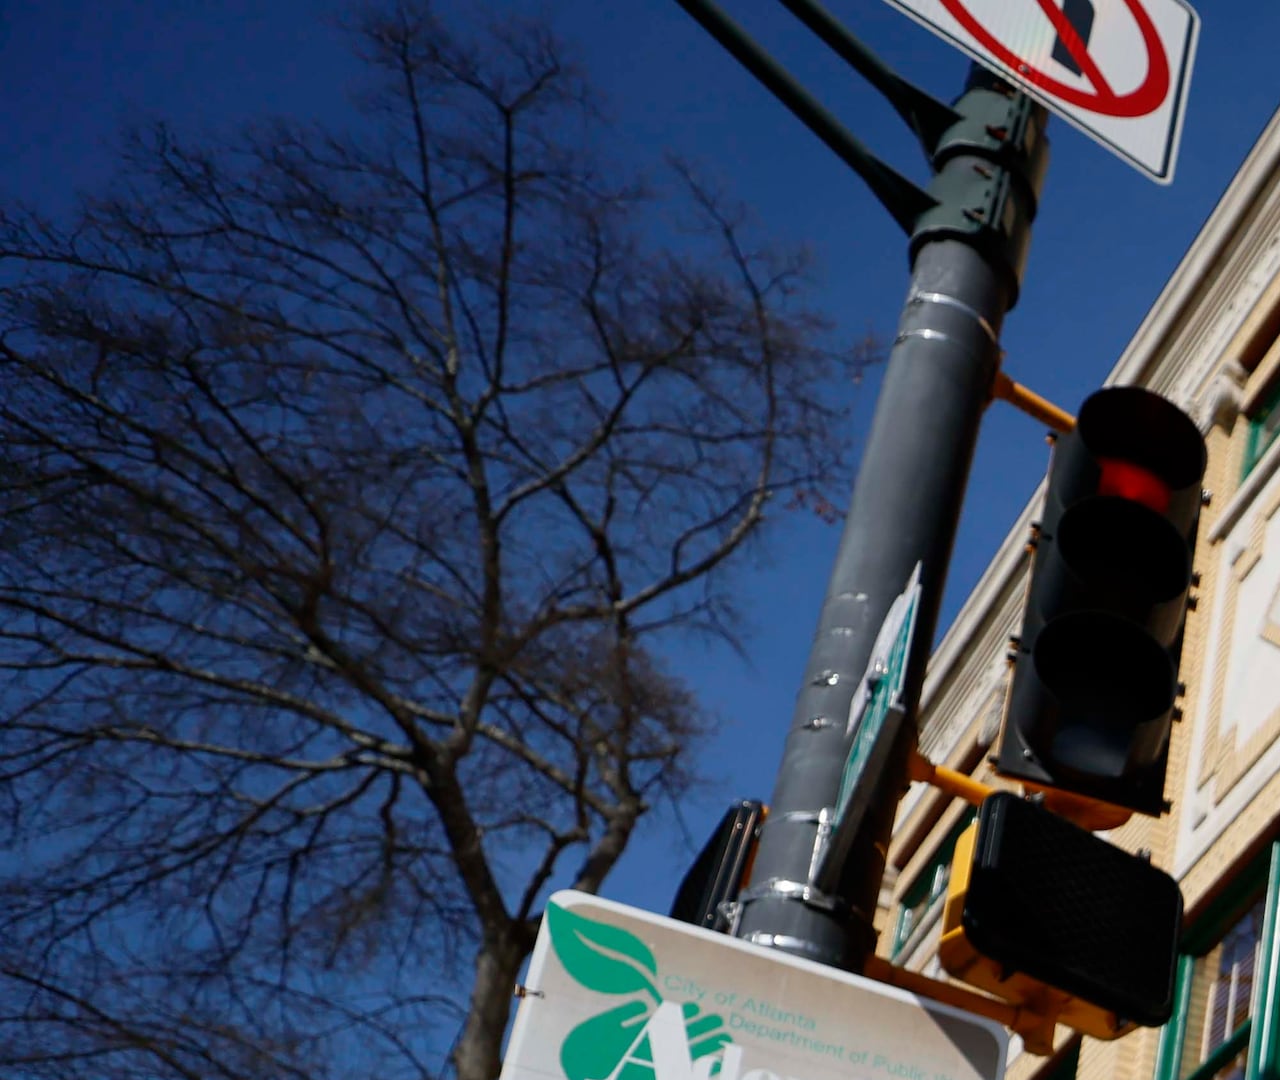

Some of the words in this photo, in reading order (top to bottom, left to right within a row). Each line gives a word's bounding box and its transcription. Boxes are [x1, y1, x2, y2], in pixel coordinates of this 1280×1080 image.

[663, 975, 707, 999] City
[714, 992, 738, 1006] of
[742, 997, 817, 1031] Atlanta
[728, 1012, 846, 1062] Department
[849, 1051, 868, 1065] of
